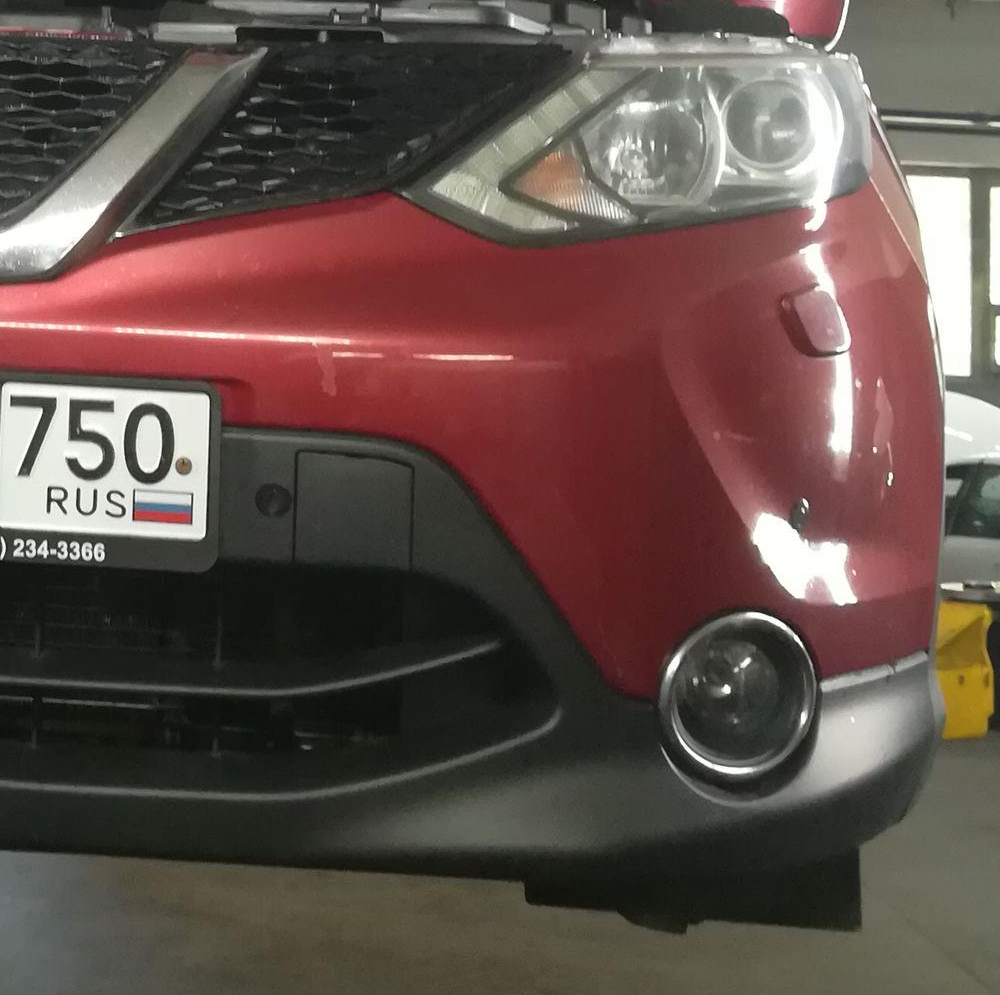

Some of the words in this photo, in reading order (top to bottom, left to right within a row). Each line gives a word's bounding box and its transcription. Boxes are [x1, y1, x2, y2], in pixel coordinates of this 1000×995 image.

[9, 394, 176, 486] 750
[45, 485, 128, 519] RUS
[12, 537, 106, 563] 234-3366
